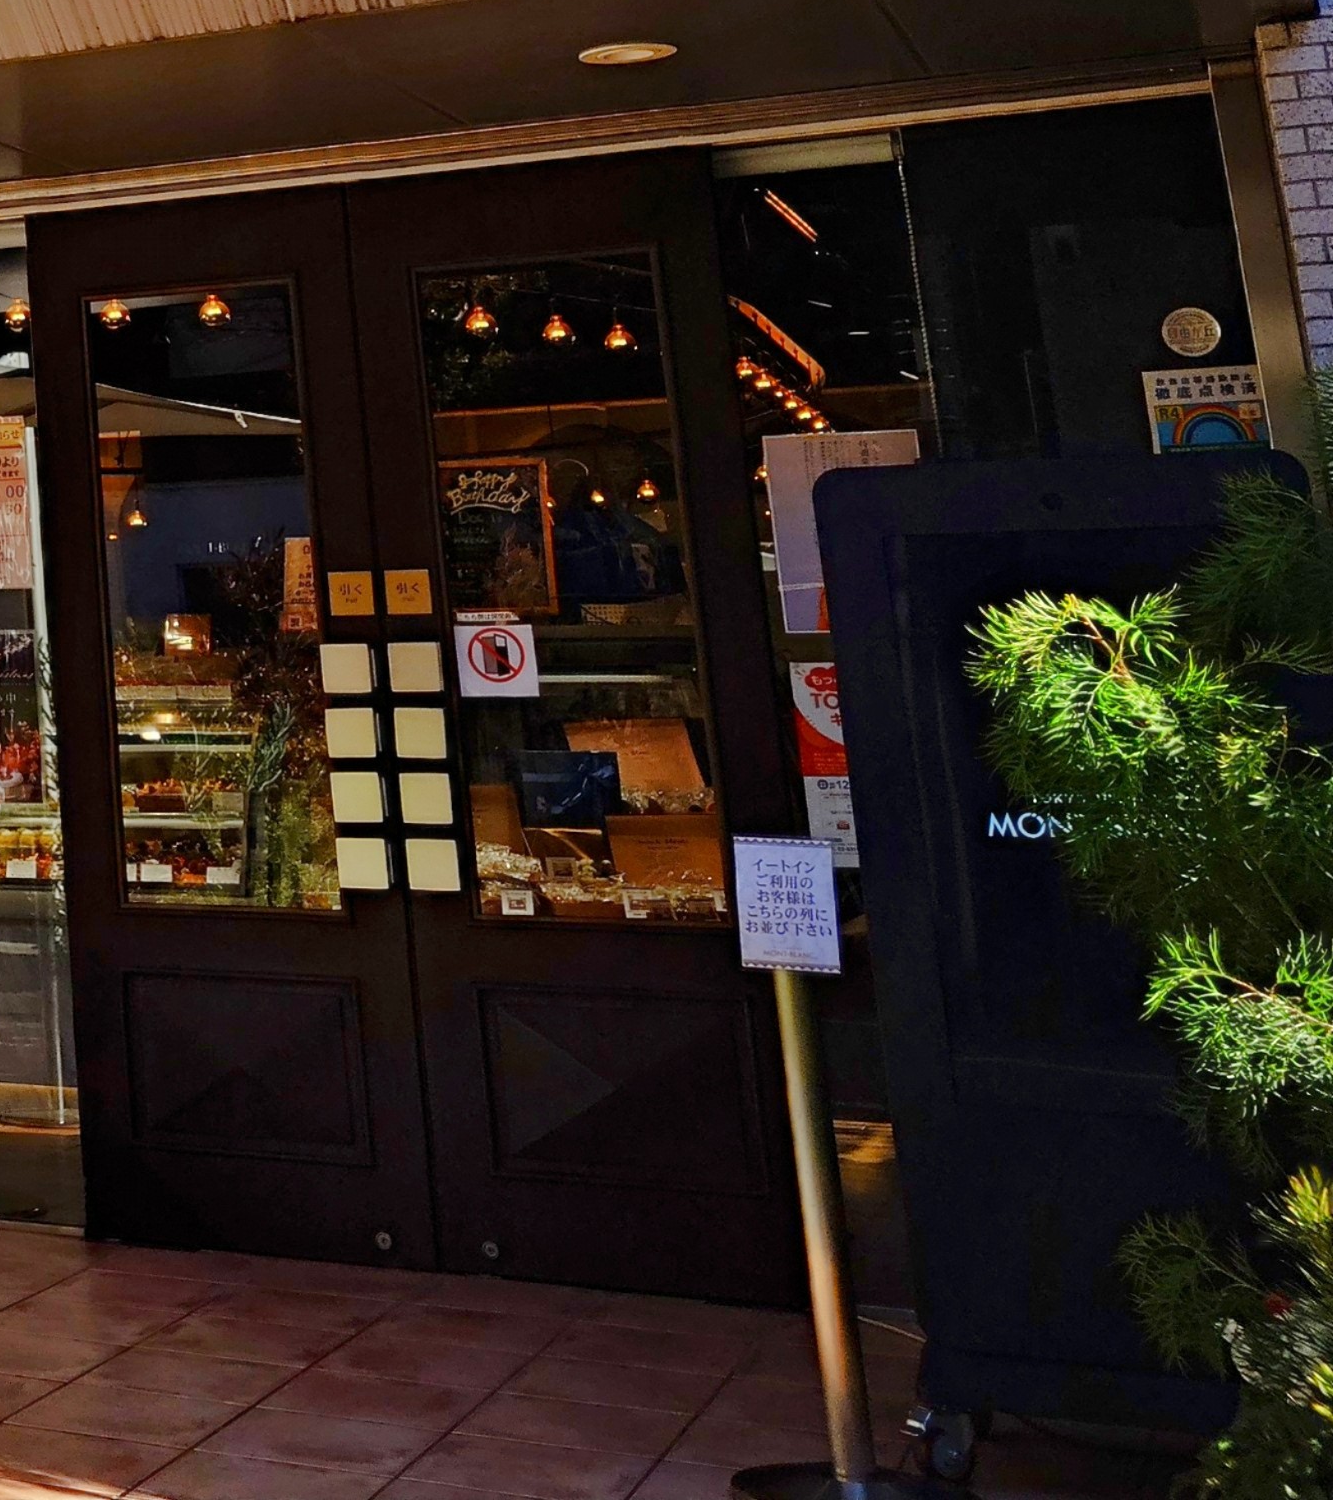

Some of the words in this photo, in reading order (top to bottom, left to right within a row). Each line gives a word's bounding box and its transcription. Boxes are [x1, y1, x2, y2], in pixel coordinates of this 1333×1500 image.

[1158, 407, 1180, 421] R4
[458, 470, 518, 492] Happy
[446, 486, 531, 514] Birthday
[340, 583, 362, 596] 引く
[396, 582, 420, 594] 引く
[753, 858, 816, 874] イートイン
[756, 873, 813, 889] ご利用の
[756, 889, 816, 905] お客様は
[747, 904, 829, 922] こちらの列に
[745, 919, 833, 937] お並び下さい
